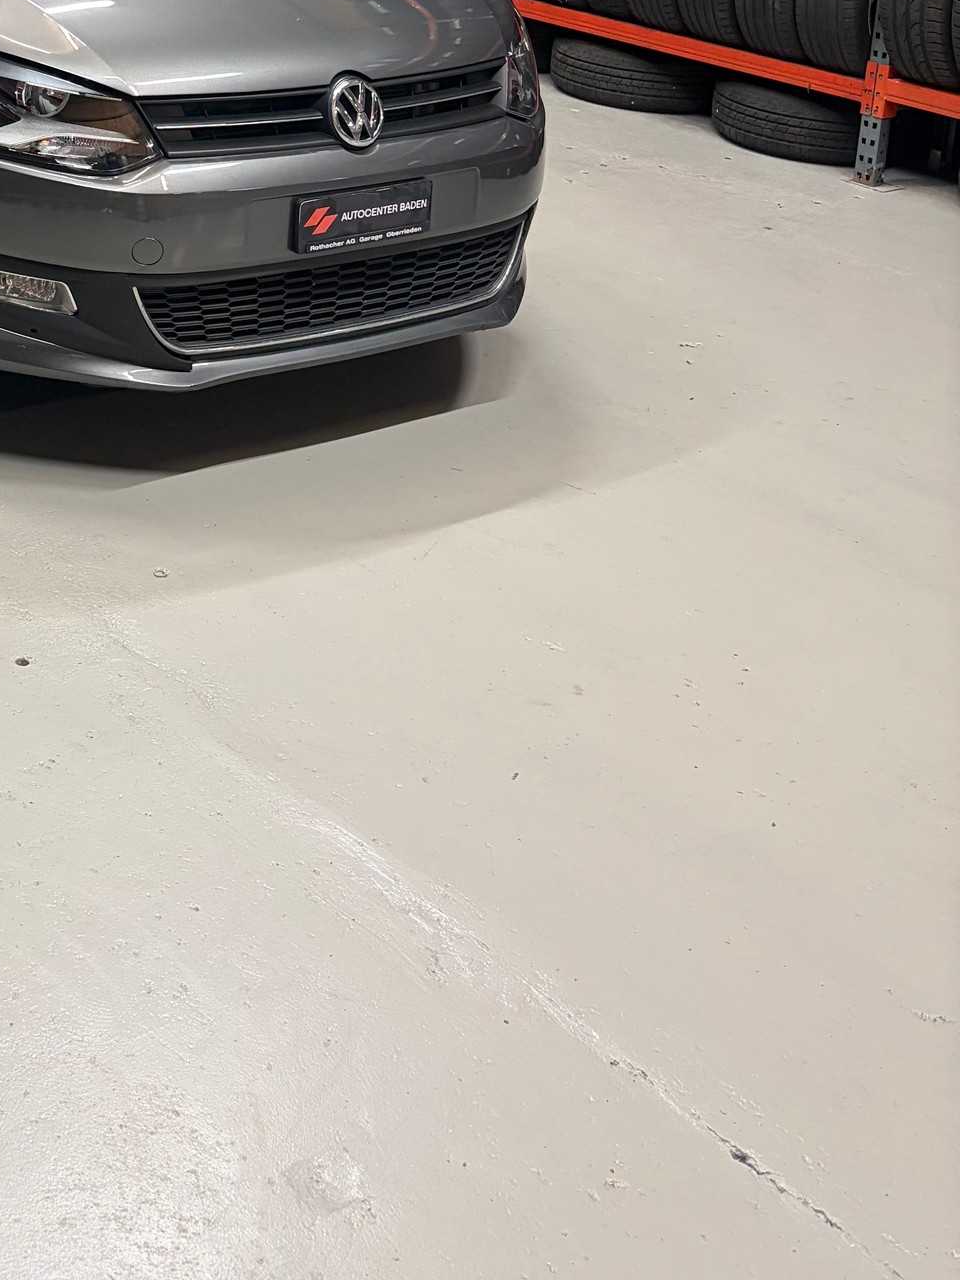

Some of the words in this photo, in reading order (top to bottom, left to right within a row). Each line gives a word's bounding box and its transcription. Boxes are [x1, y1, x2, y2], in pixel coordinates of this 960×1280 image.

[341, 203, 398, 222] AUTOCENTER
[399, 198, 428, 212] BADEN
[309, 240, 345, 252] Rothacher
[359, 233, 383, 243] Garage
[386, 226, 422, 238] Oberrieden
